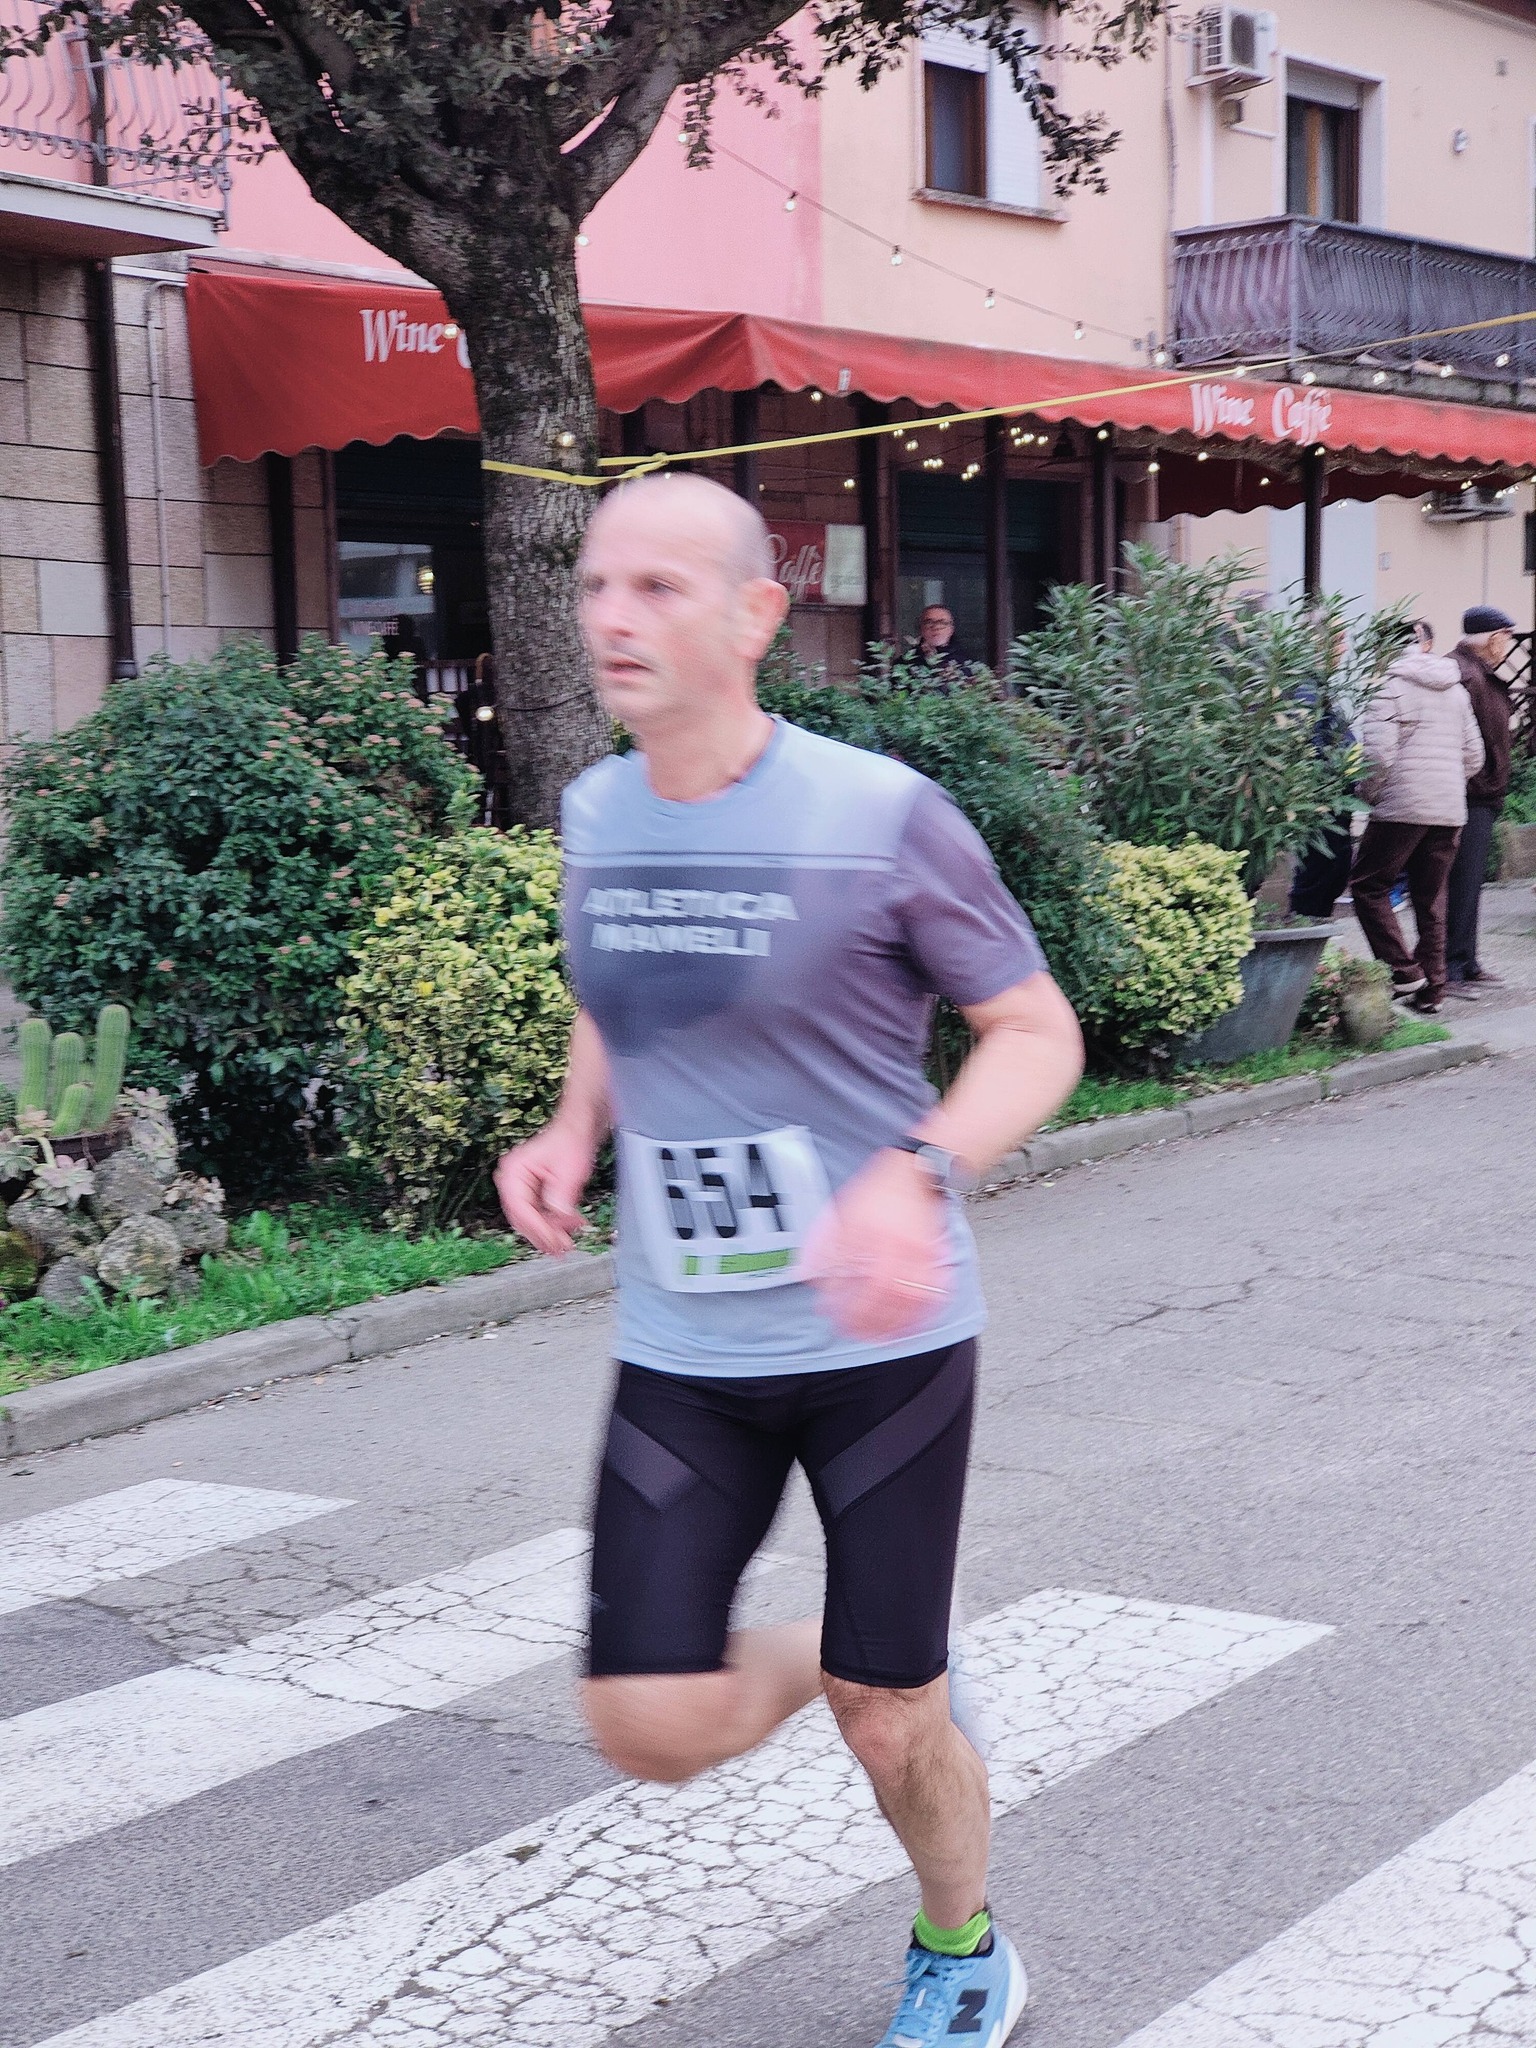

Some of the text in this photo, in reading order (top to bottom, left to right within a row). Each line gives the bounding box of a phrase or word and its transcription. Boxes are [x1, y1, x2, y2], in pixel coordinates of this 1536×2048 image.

[359, 309, 445, 363] Wine
[1189, 383, 1256, 434] Wine
[580, 887, 800, 921] ATLETICA
